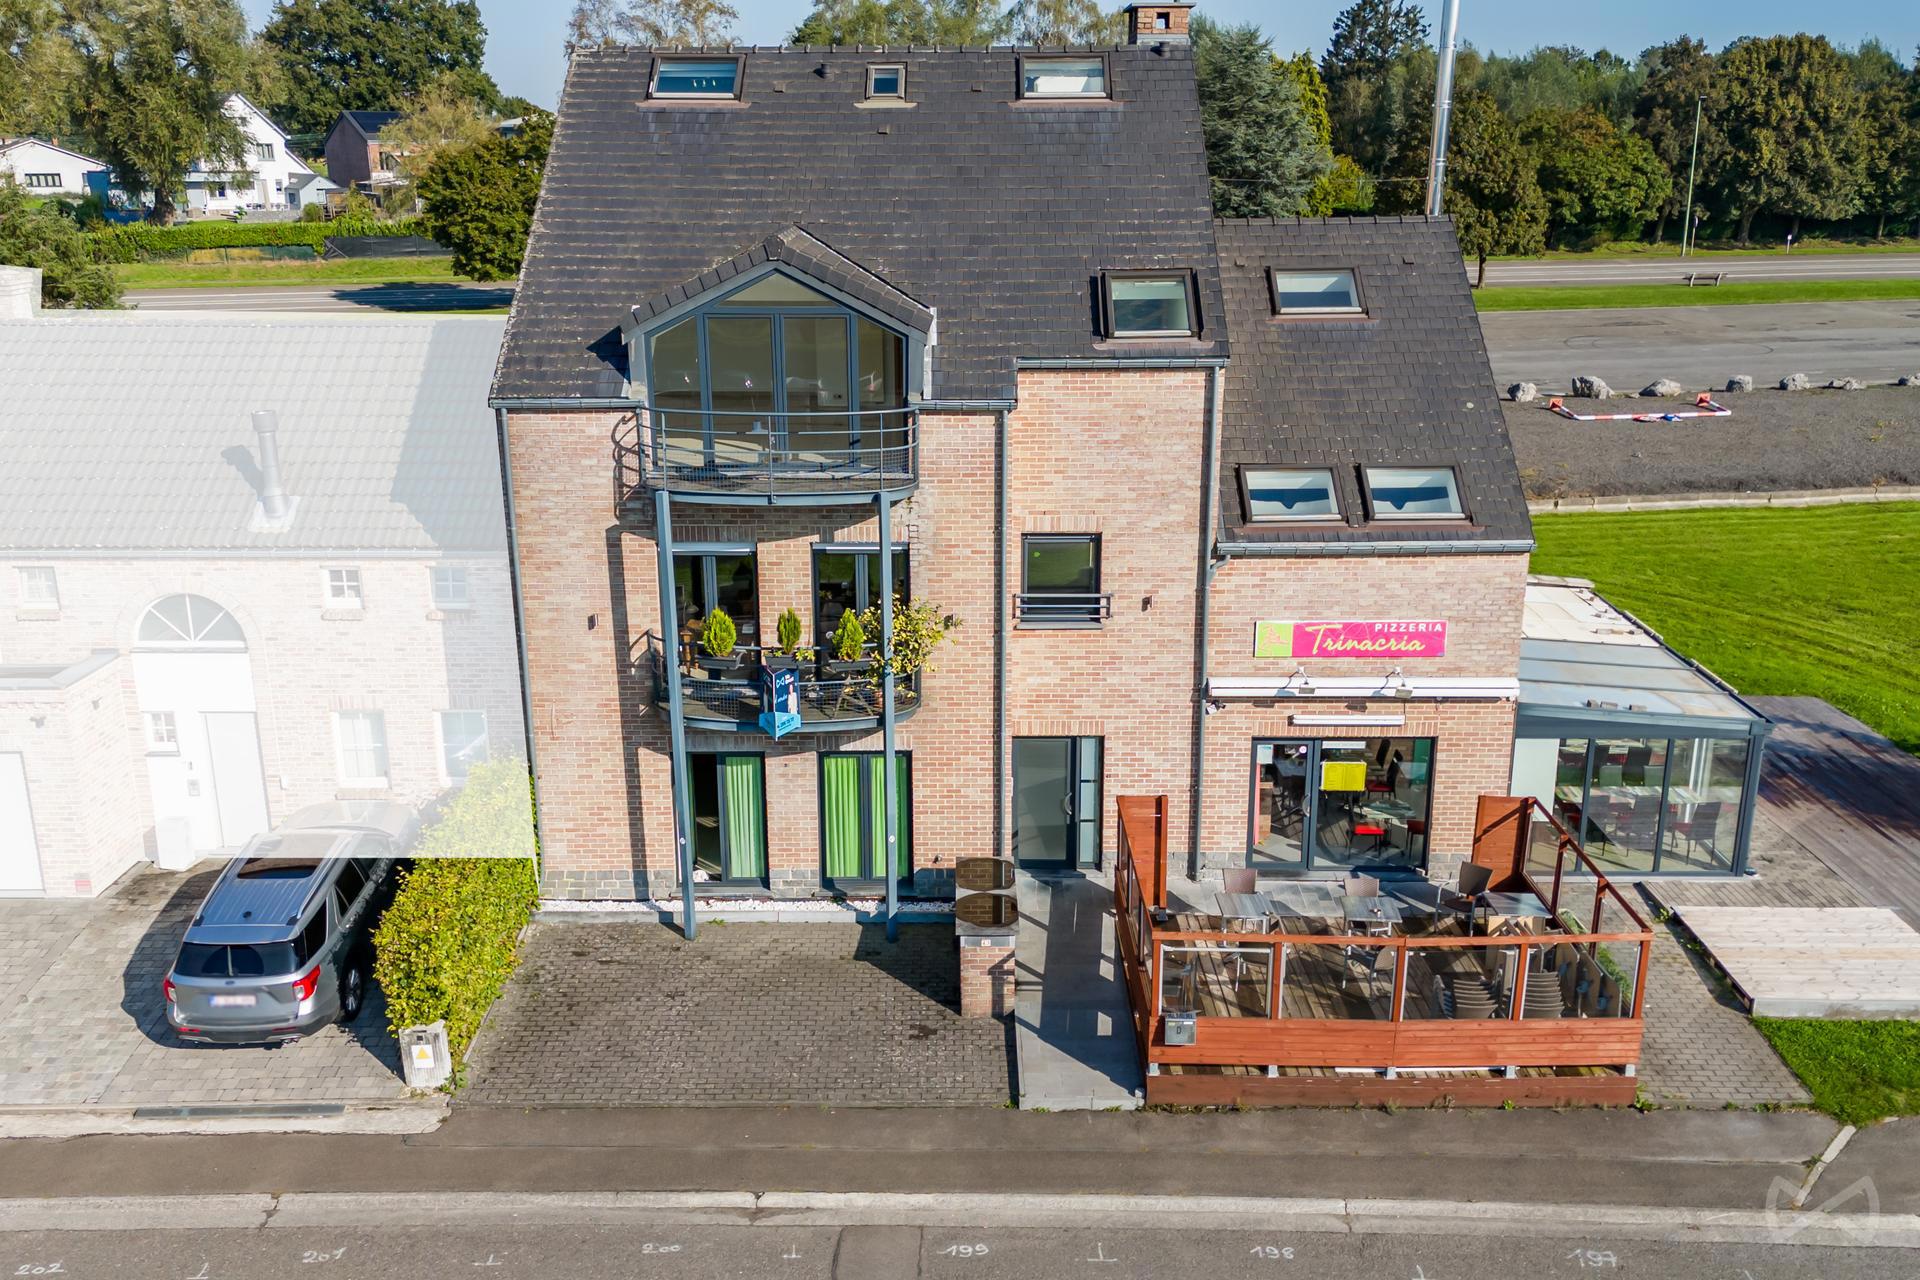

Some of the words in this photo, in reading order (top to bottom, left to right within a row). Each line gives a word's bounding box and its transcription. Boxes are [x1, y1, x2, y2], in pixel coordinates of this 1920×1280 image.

[1374, 623, 1443, 633] PIZZERIA
[1305, 623, 1426, 655] Trinacria
[641, 1243, 681, 1254] 200
[936, 1243, 990, 1258] 199
[1249, 1246, 1296, 1259] 198
[1565, 1248, 1618, 1267] 197
[14, 1260, 65, 1275] 202
